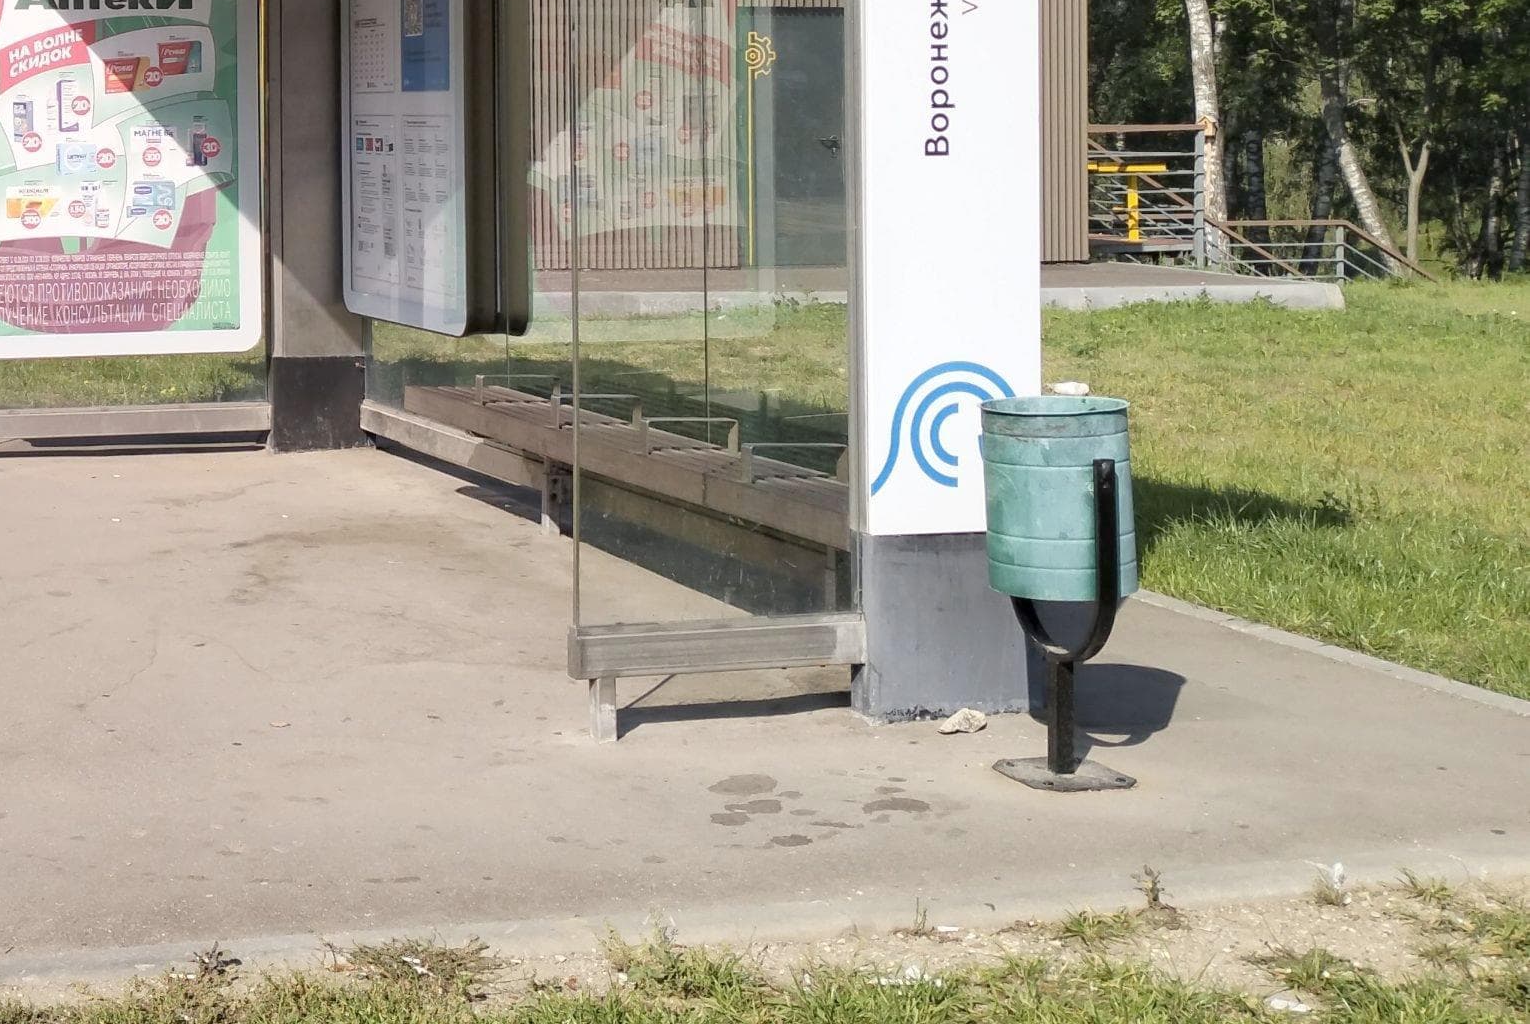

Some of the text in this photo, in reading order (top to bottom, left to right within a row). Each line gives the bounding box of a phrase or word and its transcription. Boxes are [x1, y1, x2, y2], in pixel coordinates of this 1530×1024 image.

[8, 29, 84, 63] НА ВОЛНЕ
[9, 46, 73, 78] СКИДОК
[157, 279, 230, 299] НЕОБХОДИМО
[56, 303, 145, 325] КОНСУЛЬТАЦИИ
[151, 301, 231, 322] СПЕЦИАЛИСТА
